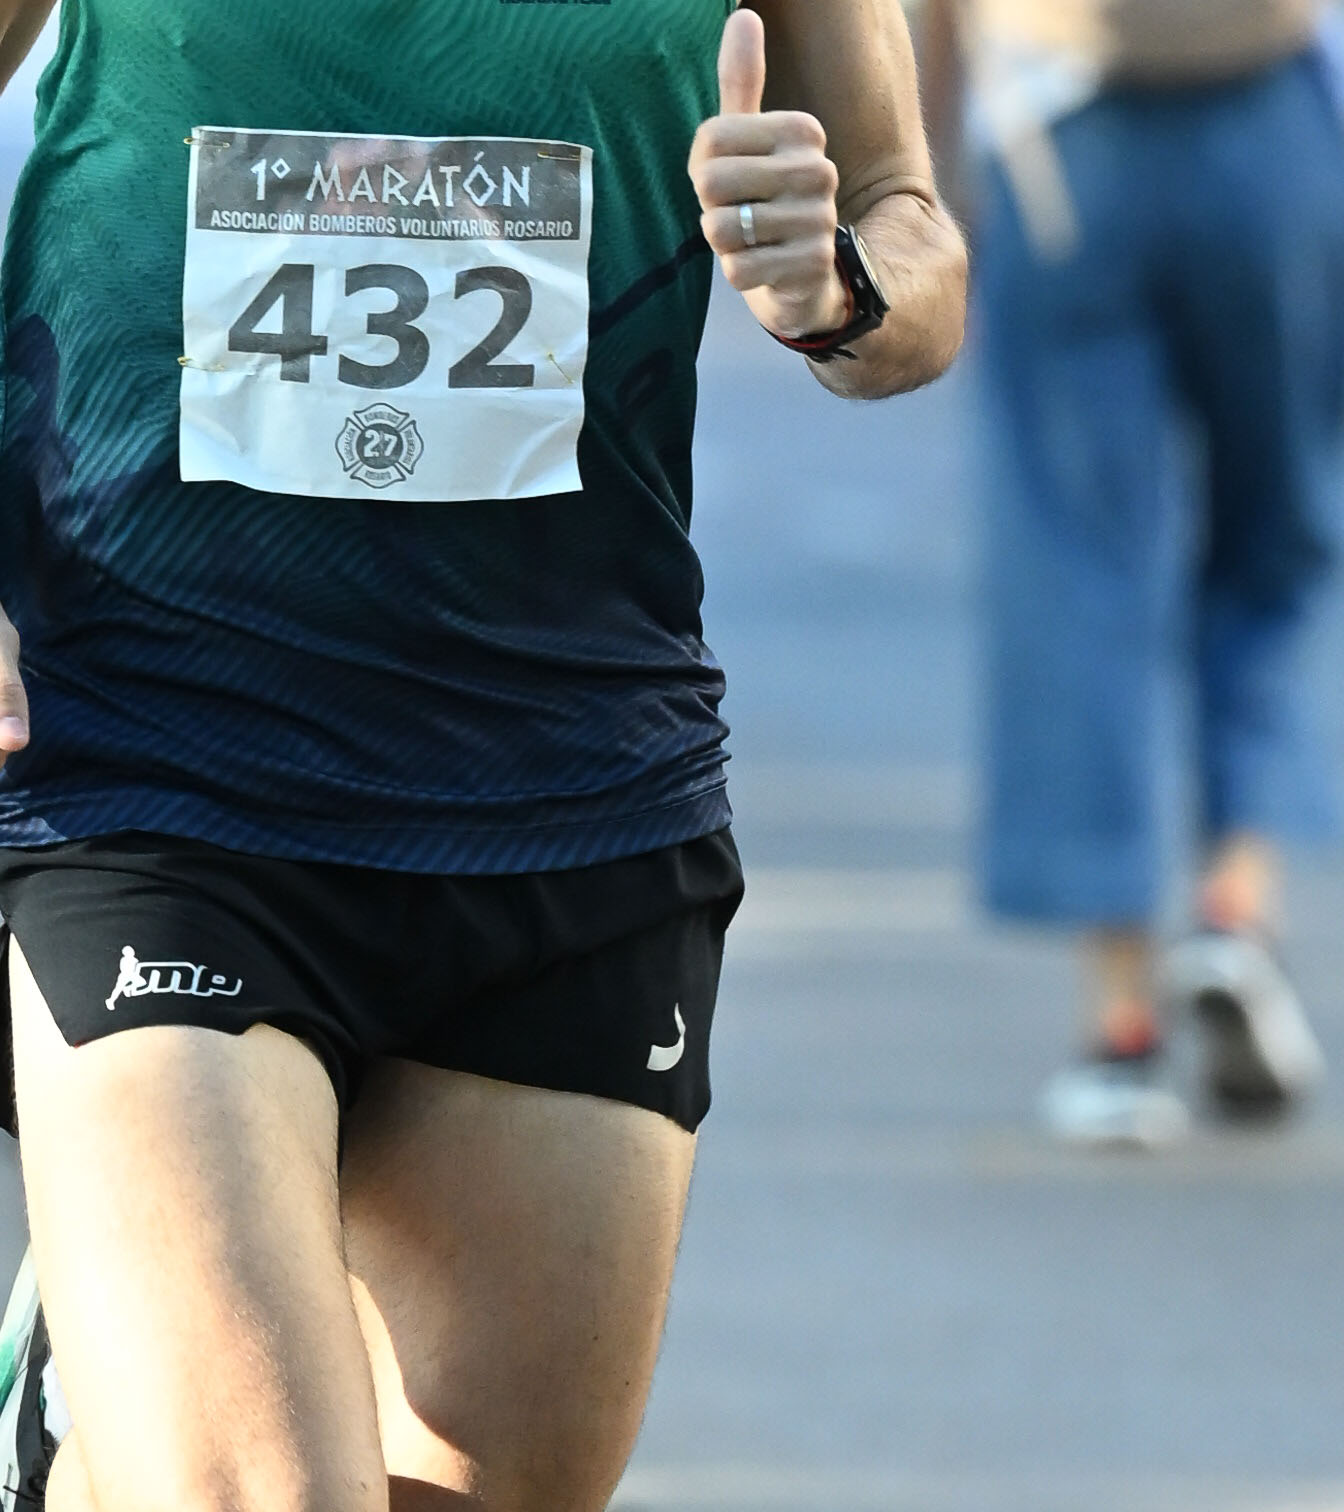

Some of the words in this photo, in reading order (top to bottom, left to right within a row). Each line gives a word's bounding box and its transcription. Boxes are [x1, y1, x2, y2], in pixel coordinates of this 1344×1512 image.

[210, 209, 304, 231] ASOCIACIÓN
[309, 214, 396, 234] BOMBEROS
[400, 217, 500, 237] VOLUNTARIOS
[505, 220, 573, 238] ROSARIO
[228, 263, 535, 389] 432
[363, 429, 398, 458] 27
